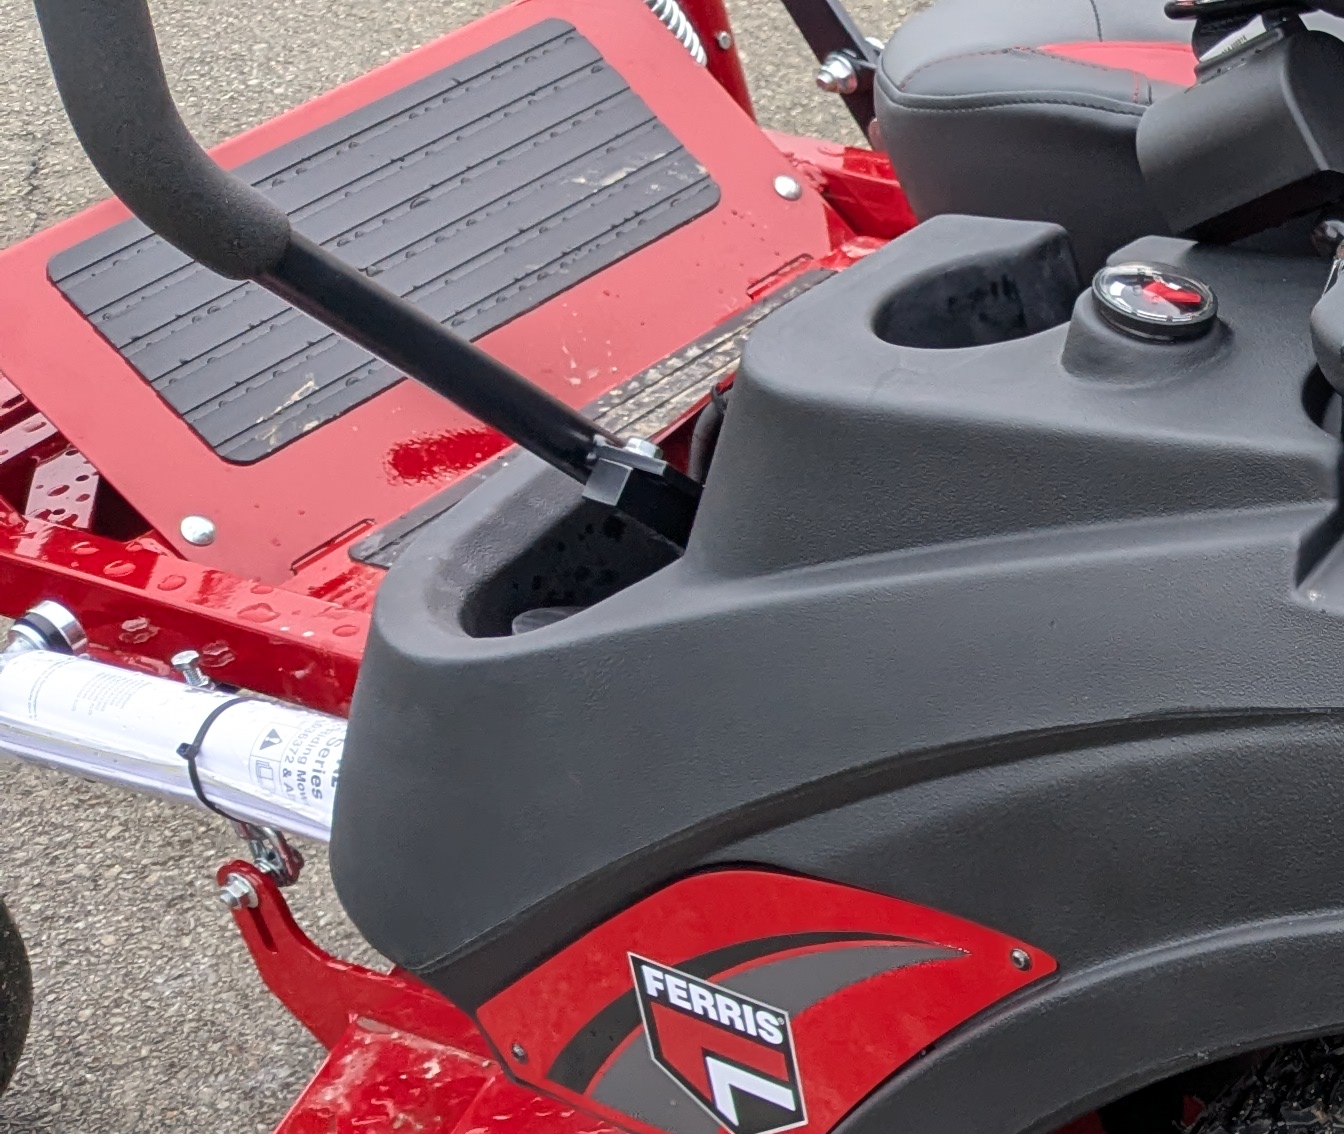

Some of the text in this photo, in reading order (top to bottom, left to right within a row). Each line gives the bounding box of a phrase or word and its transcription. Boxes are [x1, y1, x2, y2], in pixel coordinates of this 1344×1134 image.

[282, 768, 292, 778] &
[311, 737, 344, 799] Series
[640, 964, 784, 1045] FERRIS
